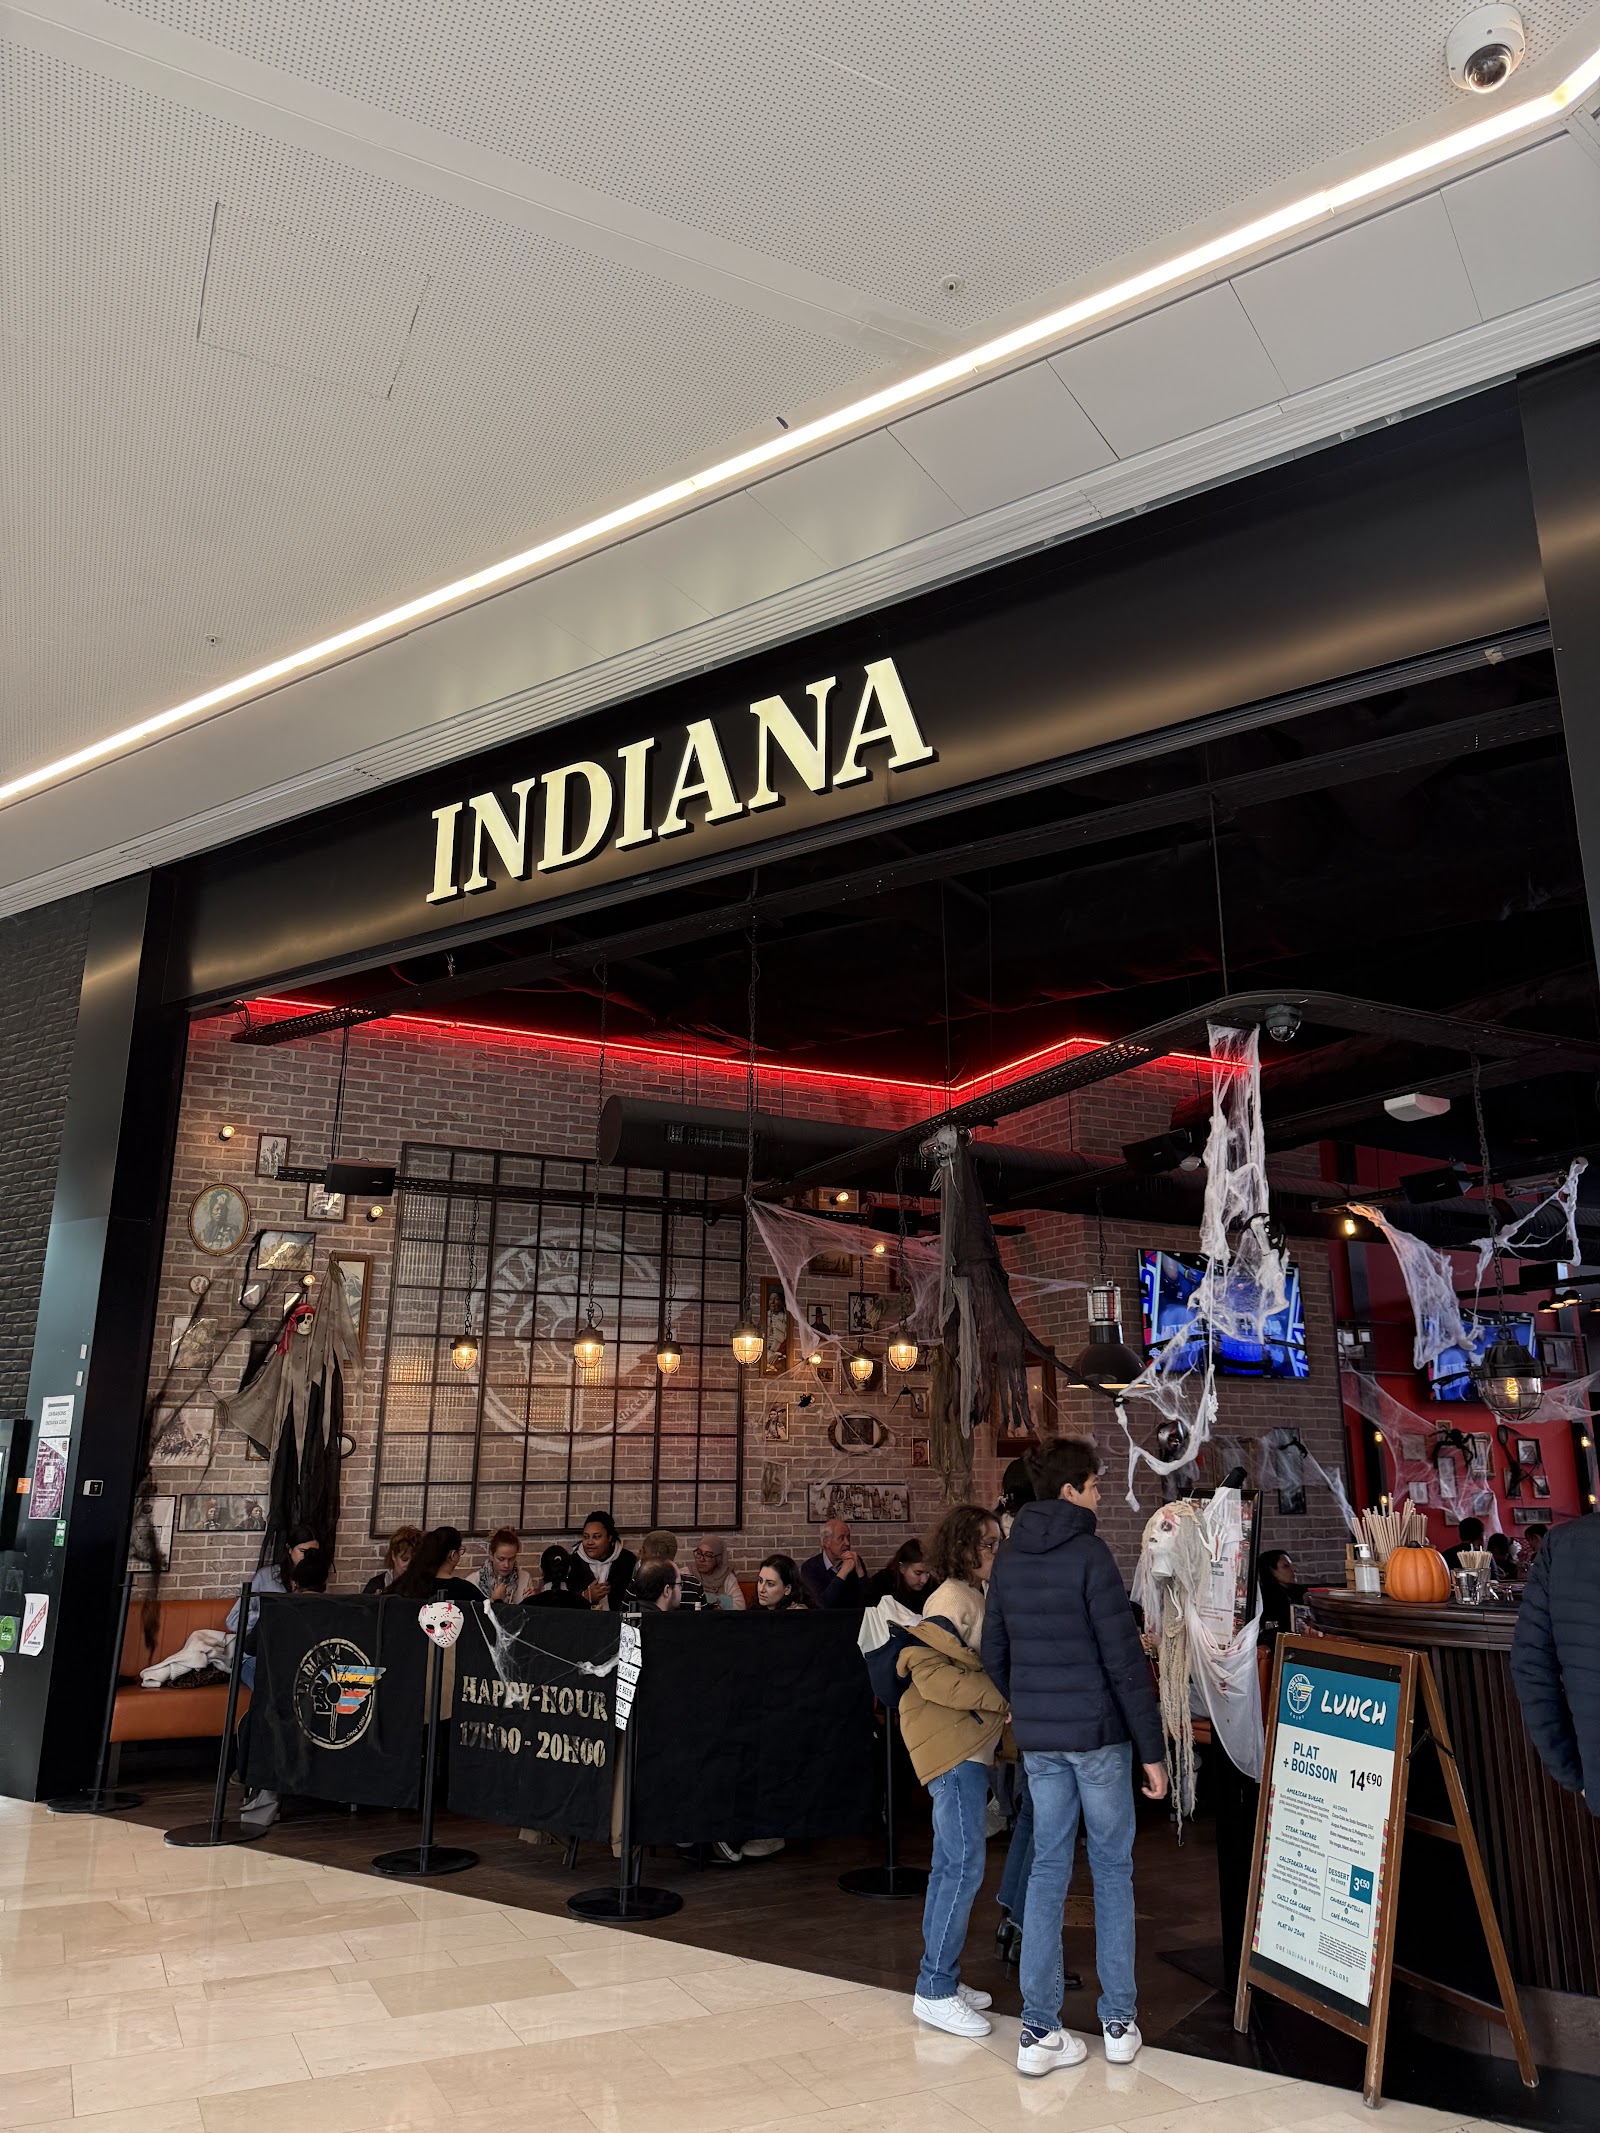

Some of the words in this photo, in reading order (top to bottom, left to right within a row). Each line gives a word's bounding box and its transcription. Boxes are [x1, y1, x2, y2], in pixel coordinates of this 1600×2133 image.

[426, 657, 935, 904] INDIANA
[462, 1676, 608, 1722] HAPPY-HOUR
[1321, 1690, 1387, 1726] LUNCH
[460, 1721, 522, 1755] 17H00
[536, 1731, 606, 1768] 20H00
[1293, 1741, 1320, 1760] PLAT
[1283, 1758, 1289, 1768] +
[1291, 1758, 1338, 1783] BOISSON
[1286, 1825, 1299, 1835] STEAK
[1304, 1864, 1317, 1874] SALAD
[1328, 1867, 1350, 1881] DESSERT
[1353, 1877, 1371, 1891] 3€50
[1347, 1903, 1364, 1914] NUTELLA
[1277, 1920, 1288, 1930] PLAT
[1286, 1948, 1307, 1962] INDIANA
[1328, 1968, 1349, 1983] COLORS
